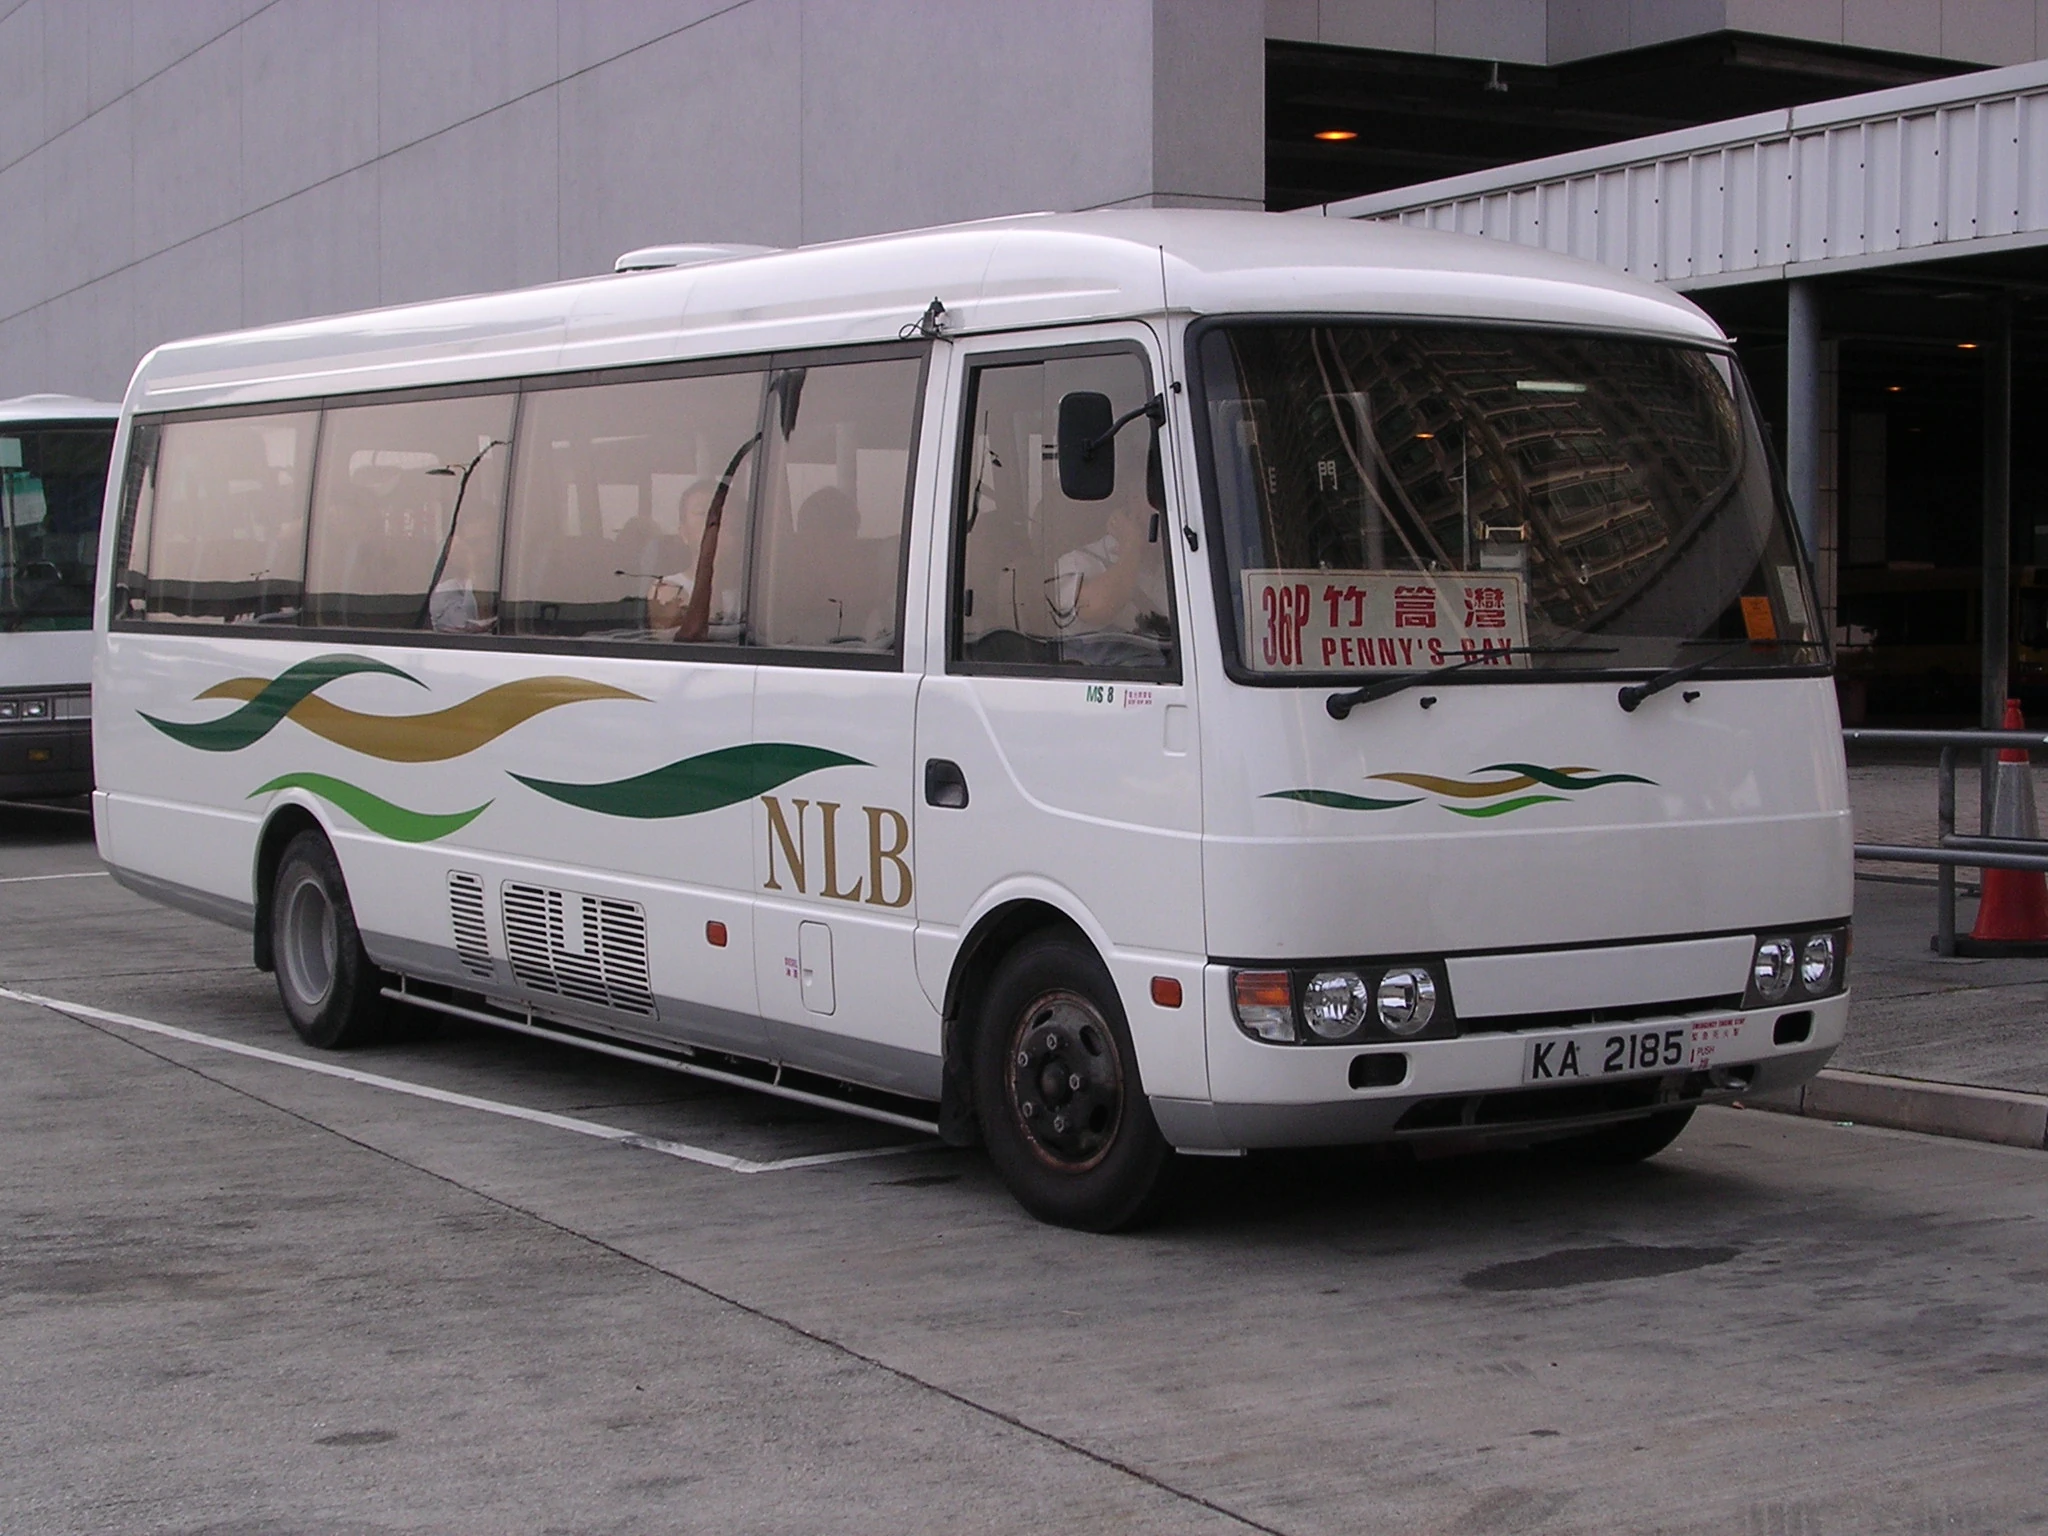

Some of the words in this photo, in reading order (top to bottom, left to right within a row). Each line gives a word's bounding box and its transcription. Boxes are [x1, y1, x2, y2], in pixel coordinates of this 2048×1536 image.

[1262, 584, 1309, 666] 36P
[1321, 637, 1444, 666] PENNY'S
[1086, 685, 1104, 703] MS
[1107, 686, 1114, 703] 8
[761, 796, 913, 907] NLB
[1532, 1040, 1579, 1079] KA
[1604, 1030, 1683, 1072] 2185
